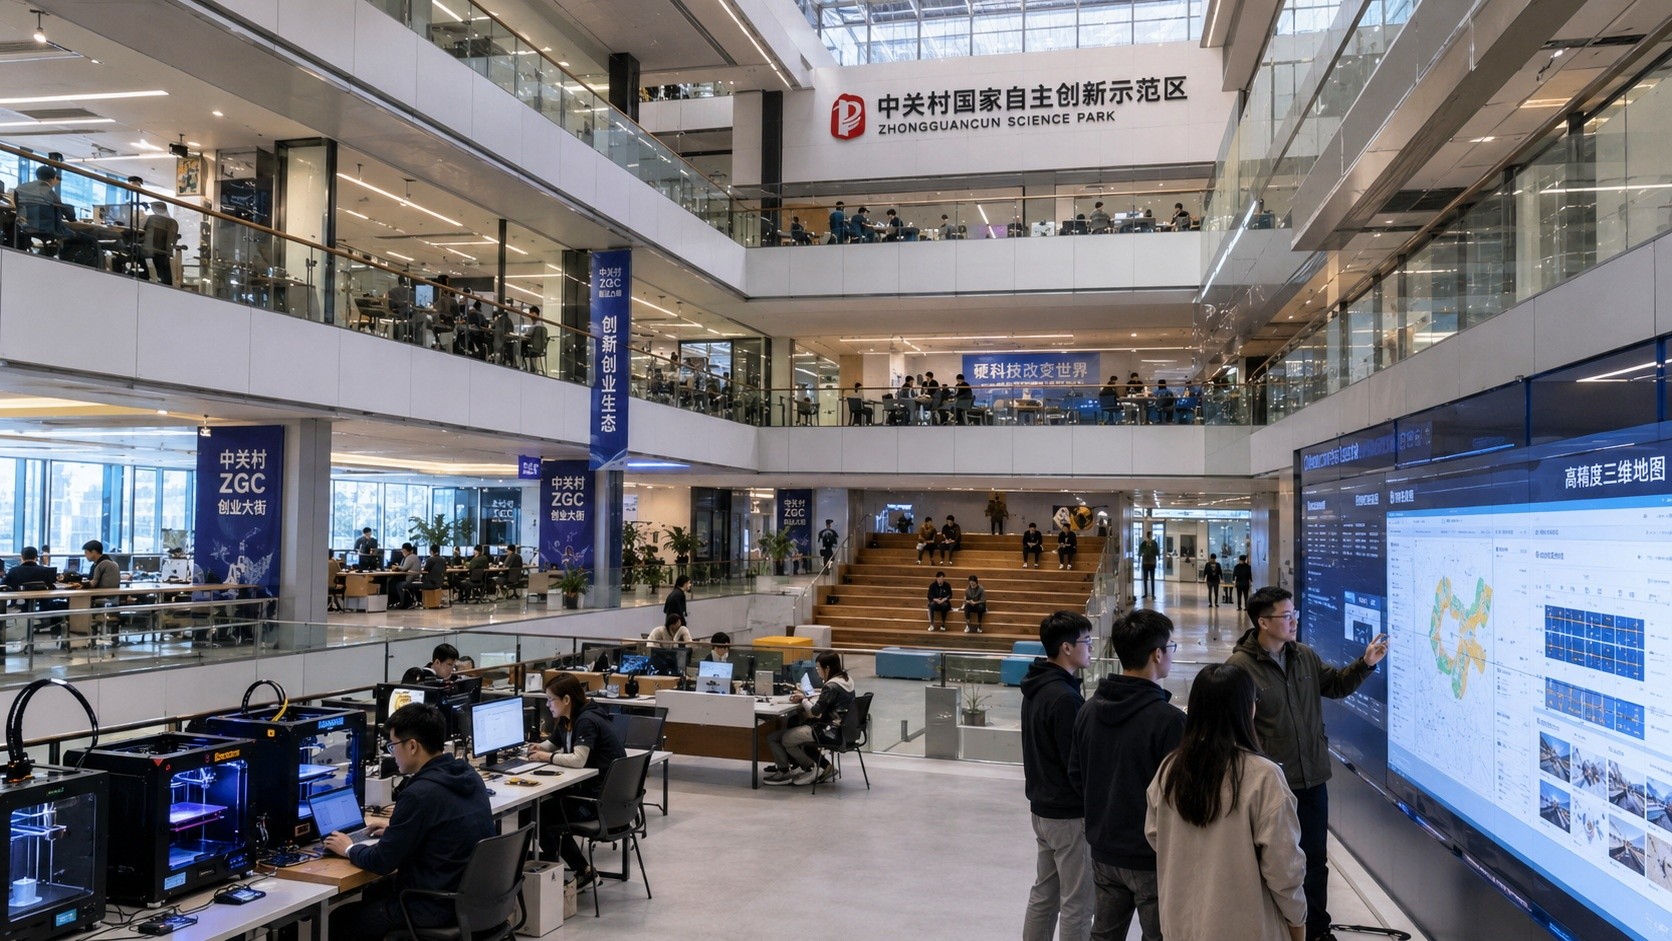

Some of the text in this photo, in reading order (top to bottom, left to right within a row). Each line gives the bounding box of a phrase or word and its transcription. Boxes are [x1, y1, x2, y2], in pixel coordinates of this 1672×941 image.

[877, 75, 1188, 119] 中关村国家自主创新示范区
[878, 110, 1116, 135] ZHONGGUANCUN SCIENCE PARK
[601, 315, 617, 433] 创新创业生态
[974, 362, 1088, 380] 硬科技改变世界
[220, 449, 267, 470] 中关村
[1564, 456, 1666, 489] 高精度三维地图
[219, 473, 266, 494] ZGC
[551, 476, 585, 491] 中关村
[218, 499, 267, 516] 创业大街
[551, 492, 584, 507] ZGC
[784, 508, 806, 517] ZGC
